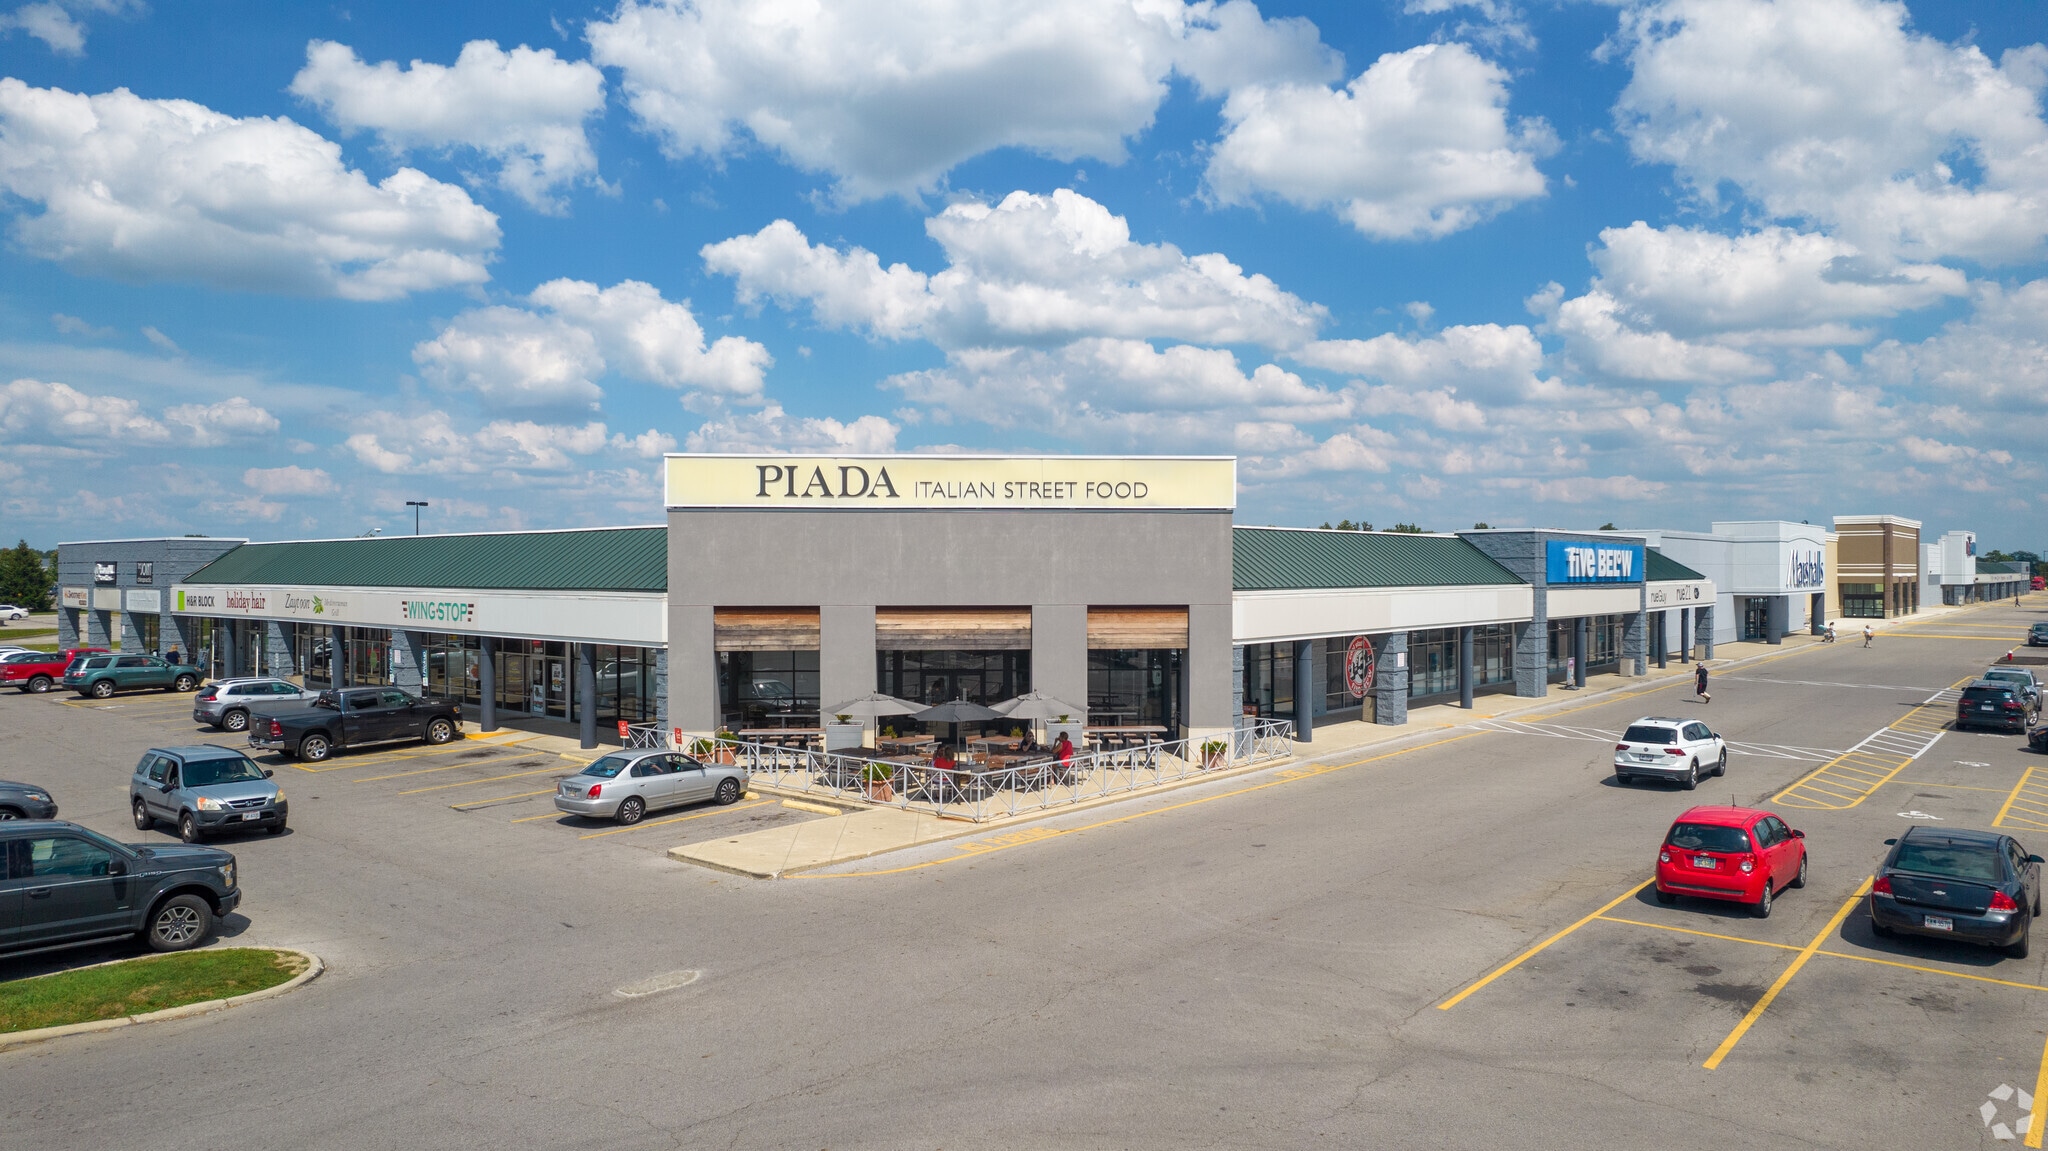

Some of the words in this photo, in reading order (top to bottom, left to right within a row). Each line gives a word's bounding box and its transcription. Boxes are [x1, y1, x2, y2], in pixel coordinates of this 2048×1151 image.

[756, 465, 901, 499] PIADA
[915, 481, 996, 499] ITALIAN
[1004, 481, 1077, 499] STREET
[1086, 481, 1149, 499] FOOD
[1564, 546, 1595, 578] five
[1597, 548, 1633, 577] BELOW
[1786, 550, 1824, 589] Marshalls
[186, 595, 198, 607] H&R
[198, 595, 215, 607] BLOCK
[226, 590, 251, 614] holiday
[251, 591, 266, 610] hair
